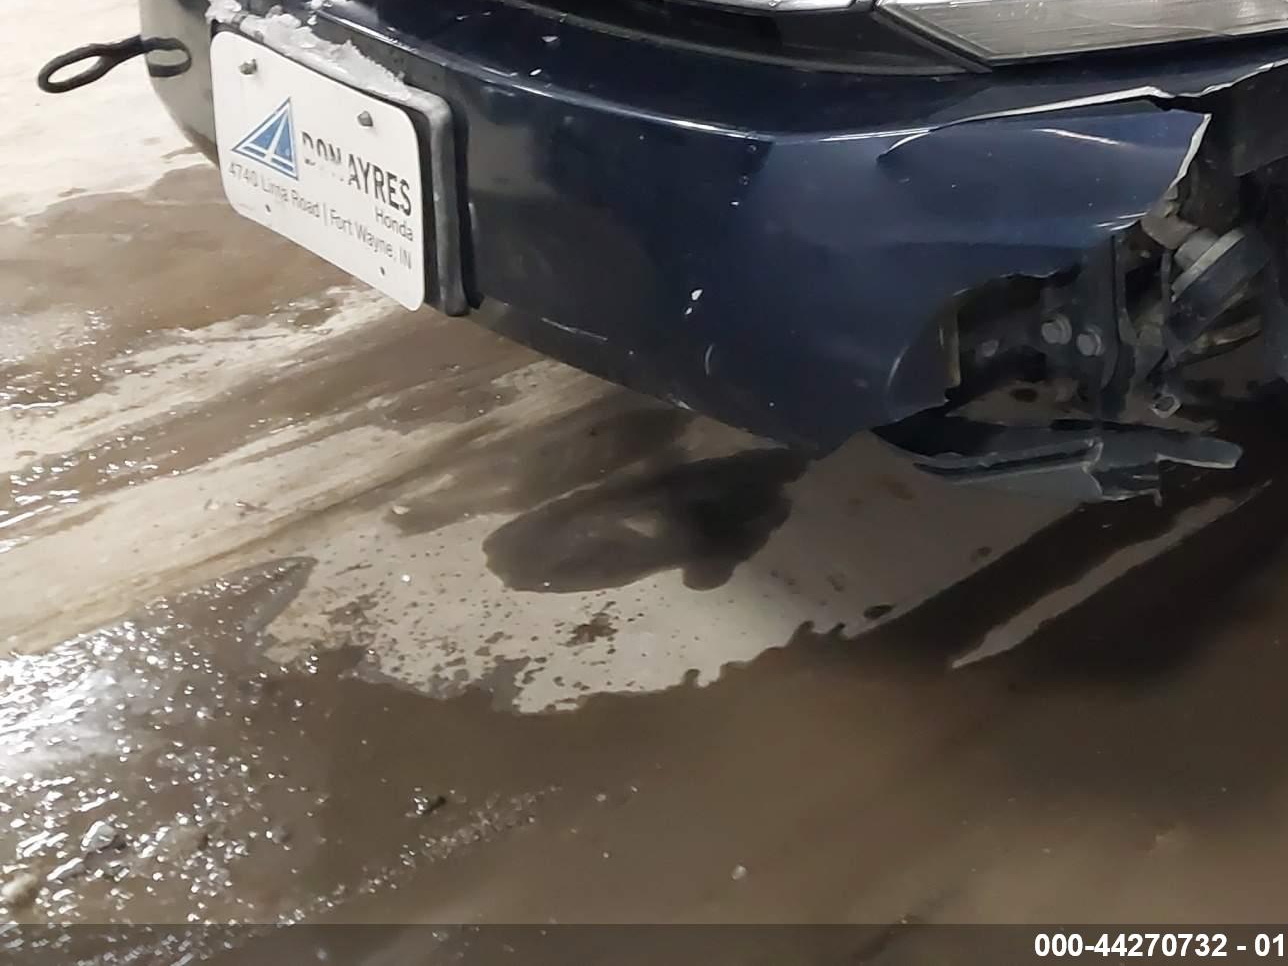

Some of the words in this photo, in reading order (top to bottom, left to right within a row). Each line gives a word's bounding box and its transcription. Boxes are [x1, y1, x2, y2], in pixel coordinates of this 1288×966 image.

[348, 153, 412, 217] AYRES
[261, 173, 290, 202] Lima
[290, 189, 321, 218] Road
[330, 208, 354, 236] Fort
[354, 221, 398, 262] Wayne,
[400, 245, 413, 270] IN
[374, 205, 414, 242] Honda
